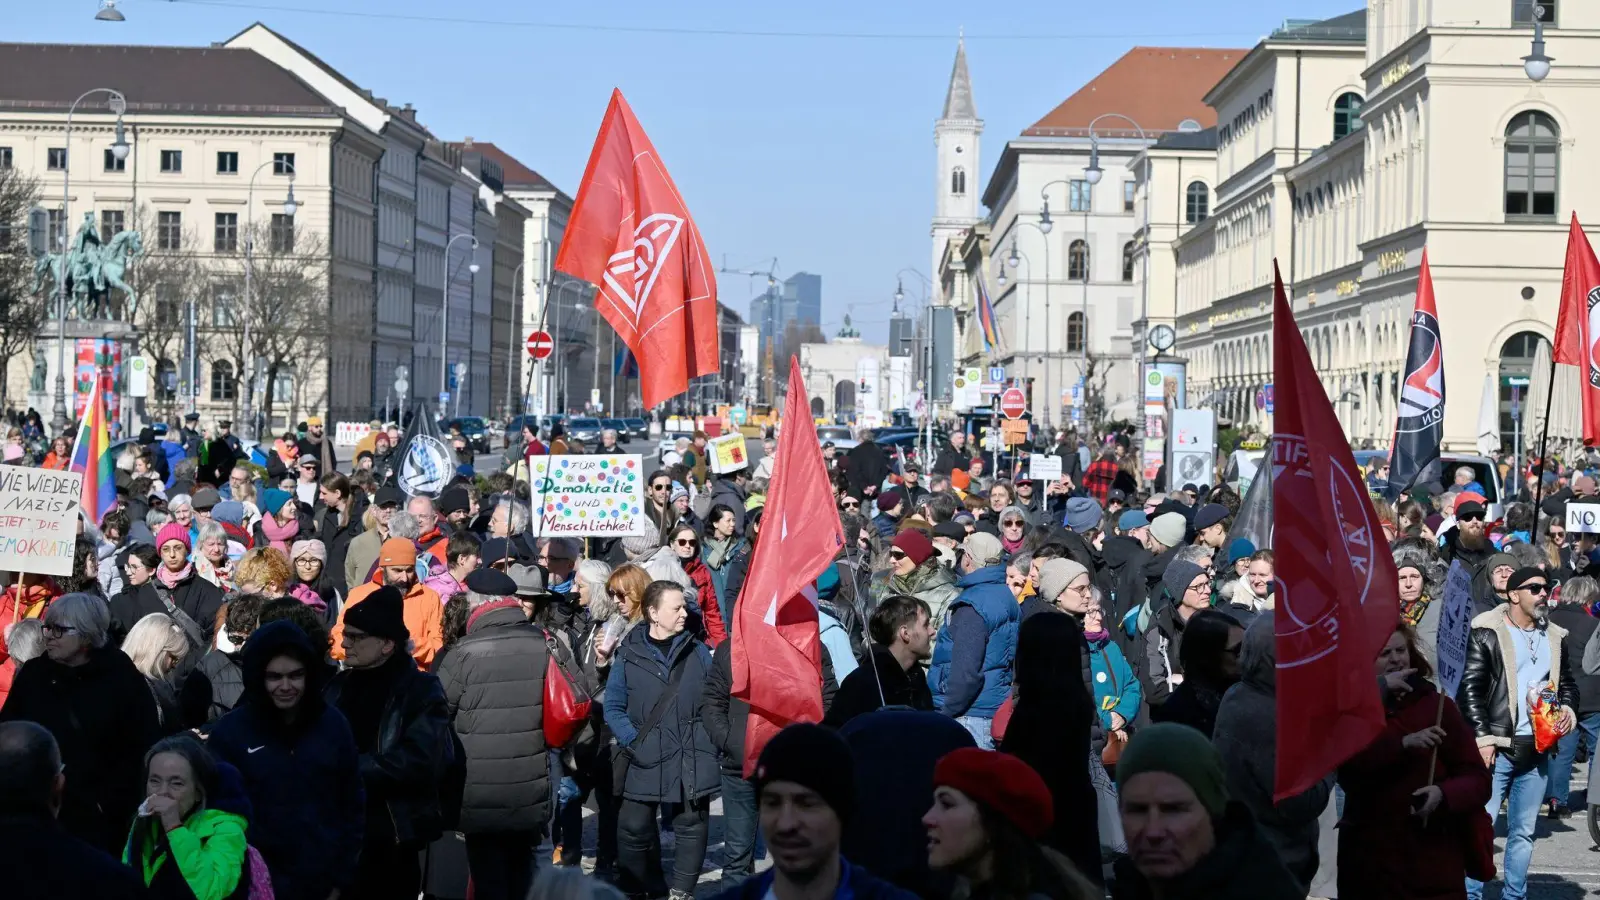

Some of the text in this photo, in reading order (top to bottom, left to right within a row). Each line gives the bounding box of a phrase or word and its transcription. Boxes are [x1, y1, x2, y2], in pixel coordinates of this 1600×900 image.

[570, 460, 596, 470] FÜR
[537, 476, 633, 494] Demokratie
[573, 498, 600, 508] UND
[36, 518, 60, 531] DIE
[540, 514, 635, 532] Menschlichkeit
[1459, 597, 1472, 651] LEAGUE
